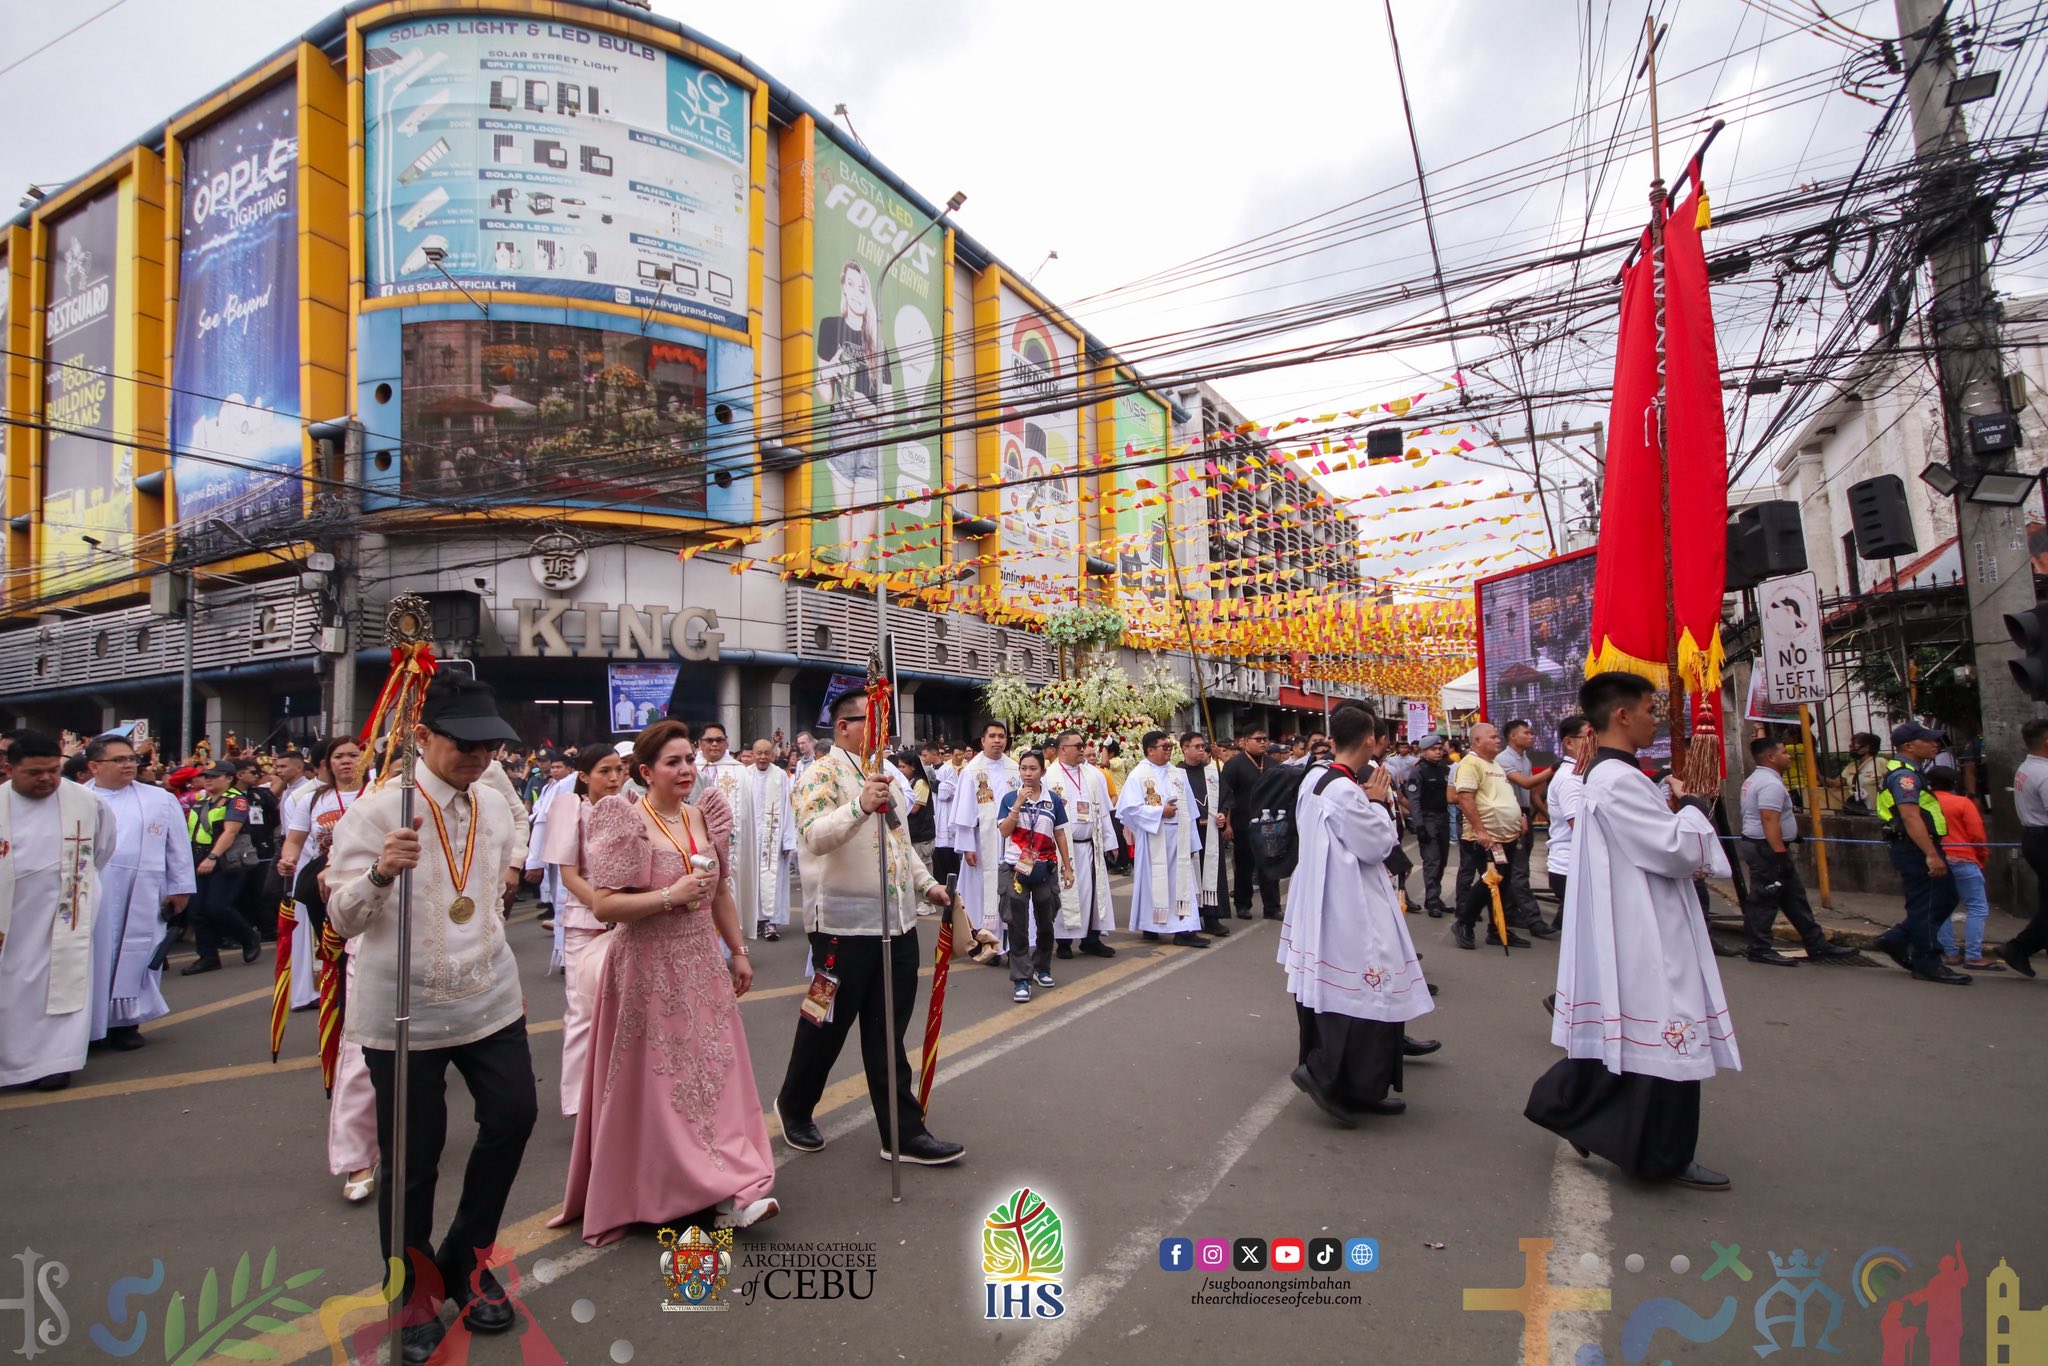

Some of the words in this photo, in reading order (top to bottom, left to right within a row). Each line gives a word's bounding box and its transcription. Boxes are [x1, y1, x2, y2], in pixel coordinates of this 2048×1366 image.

[389, 22, 450, 44] SOLAR
[457, 21, 519, 36] LIGHT
[526, 23, 540, 36] &
[547, 25, 591, 45] LED
[598, 35, 656, 62] BULB
[488, 50, 528, 58] SOLAR
[532, 53, 579, 65] STREET
[583, 61, 619, 73] LIGHT
[485, 121, 522, 130] SOLAR
[670, 123, 699, 140] ENERGY
[700, 134, 714, 146] FOR
[680, 109, 732, 143] VLG
[635, 133, 657, 145] LED
[659, 139, 687, 154] BULB
[193, 138, 288, 225] OPPLE
[485, 171, 523, 180] SOLAR
[839, 160, 886, 209] BASTA
[636, 183, 673, 199] PANEL
[229, 188, 287, 230] LIGHTING
[887, 198, 914, 230] LED
[486, 221, 524, 230] SOLAR
[526, 223, 550, 232] LED
[824, 183, 937, 275] FOCUS
[396, 285, 415, 295] VLG
[416, 282, 449, 292] SOLAR
[450, 280, 498, 290] OFFICIAL
[500, 281, 516, 290] PH
[47, 282, 109, 339] BESTGUARD
[198, 308, 221, 340] See
[223, 282, 272, 335] Beyond
[62, 353, 85, 375] BEST
[62, 364, 95, 392] TOOLS
[46, 380, 107, 419] BUILDING
[513, 598, 725, 662] KING
[1778, 647, 1808, 668] NO
[1775, 669, 1816, 686] LEFT
[1776, 685, 1821, 701] TURN
[1409, 703, 1427, 711] D-3
